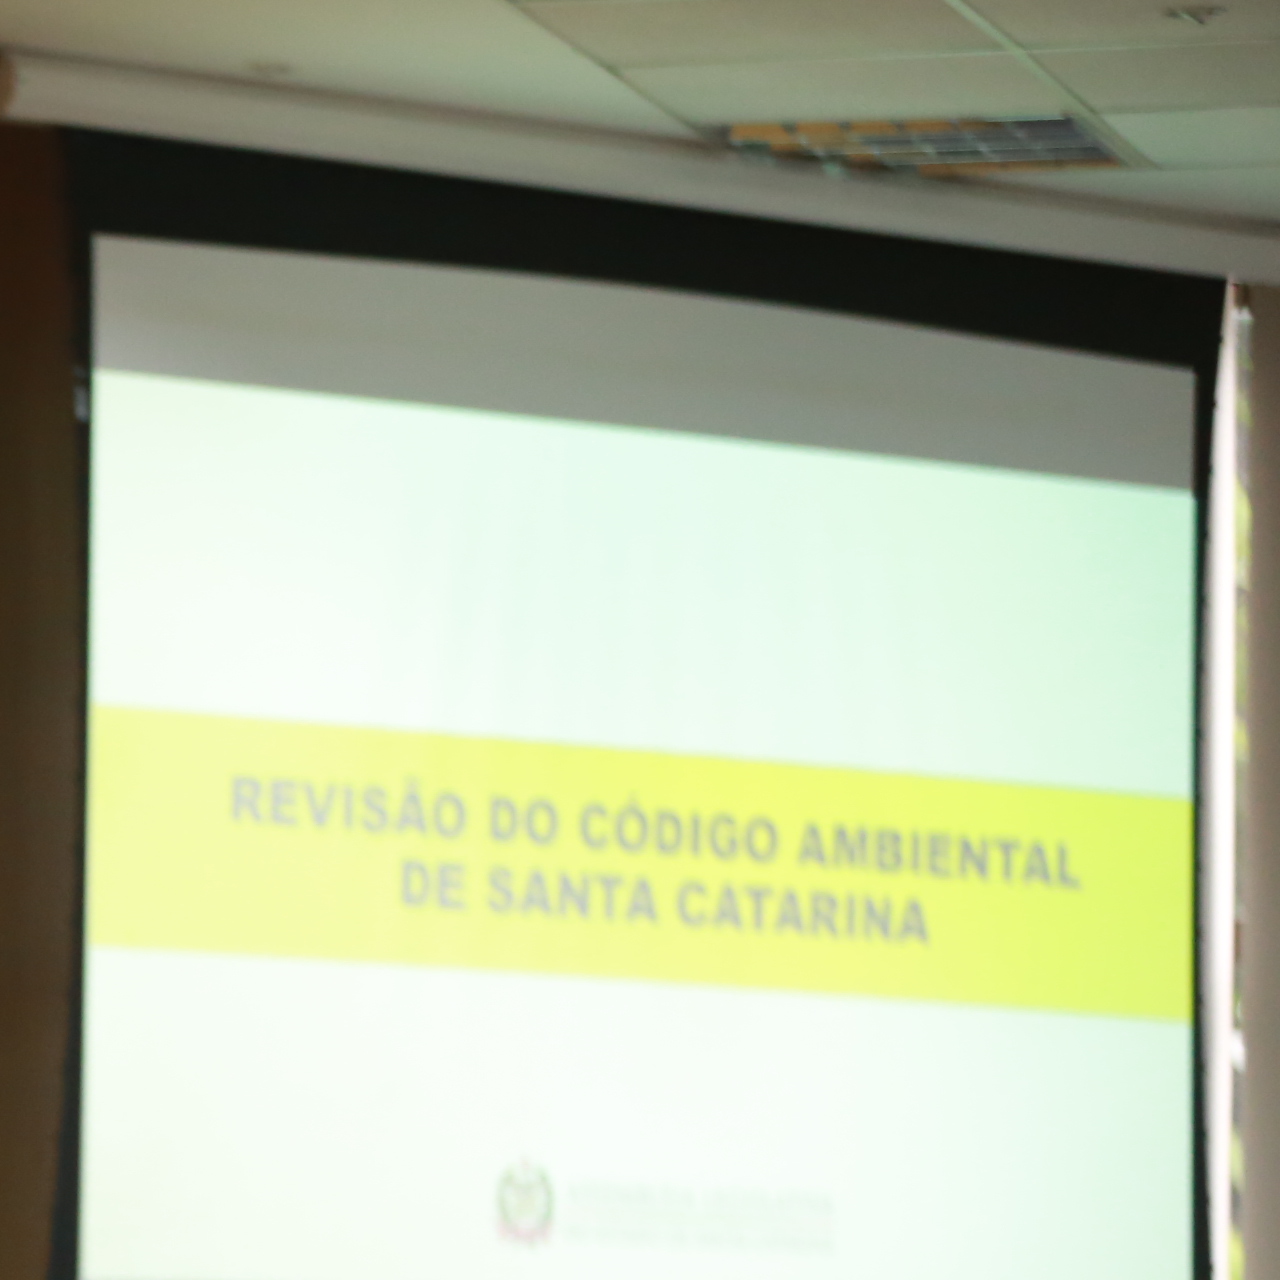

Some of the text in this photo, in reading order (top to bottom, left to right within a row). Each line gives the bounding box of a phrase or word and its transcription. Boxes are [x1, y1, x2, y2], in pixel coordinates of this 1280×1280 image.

[231, 774, 1082, 889] REVISÃO DO CÓDIGO AMBIENTAL
[400, 859, 930, 944] DE SANTA CATARINA
